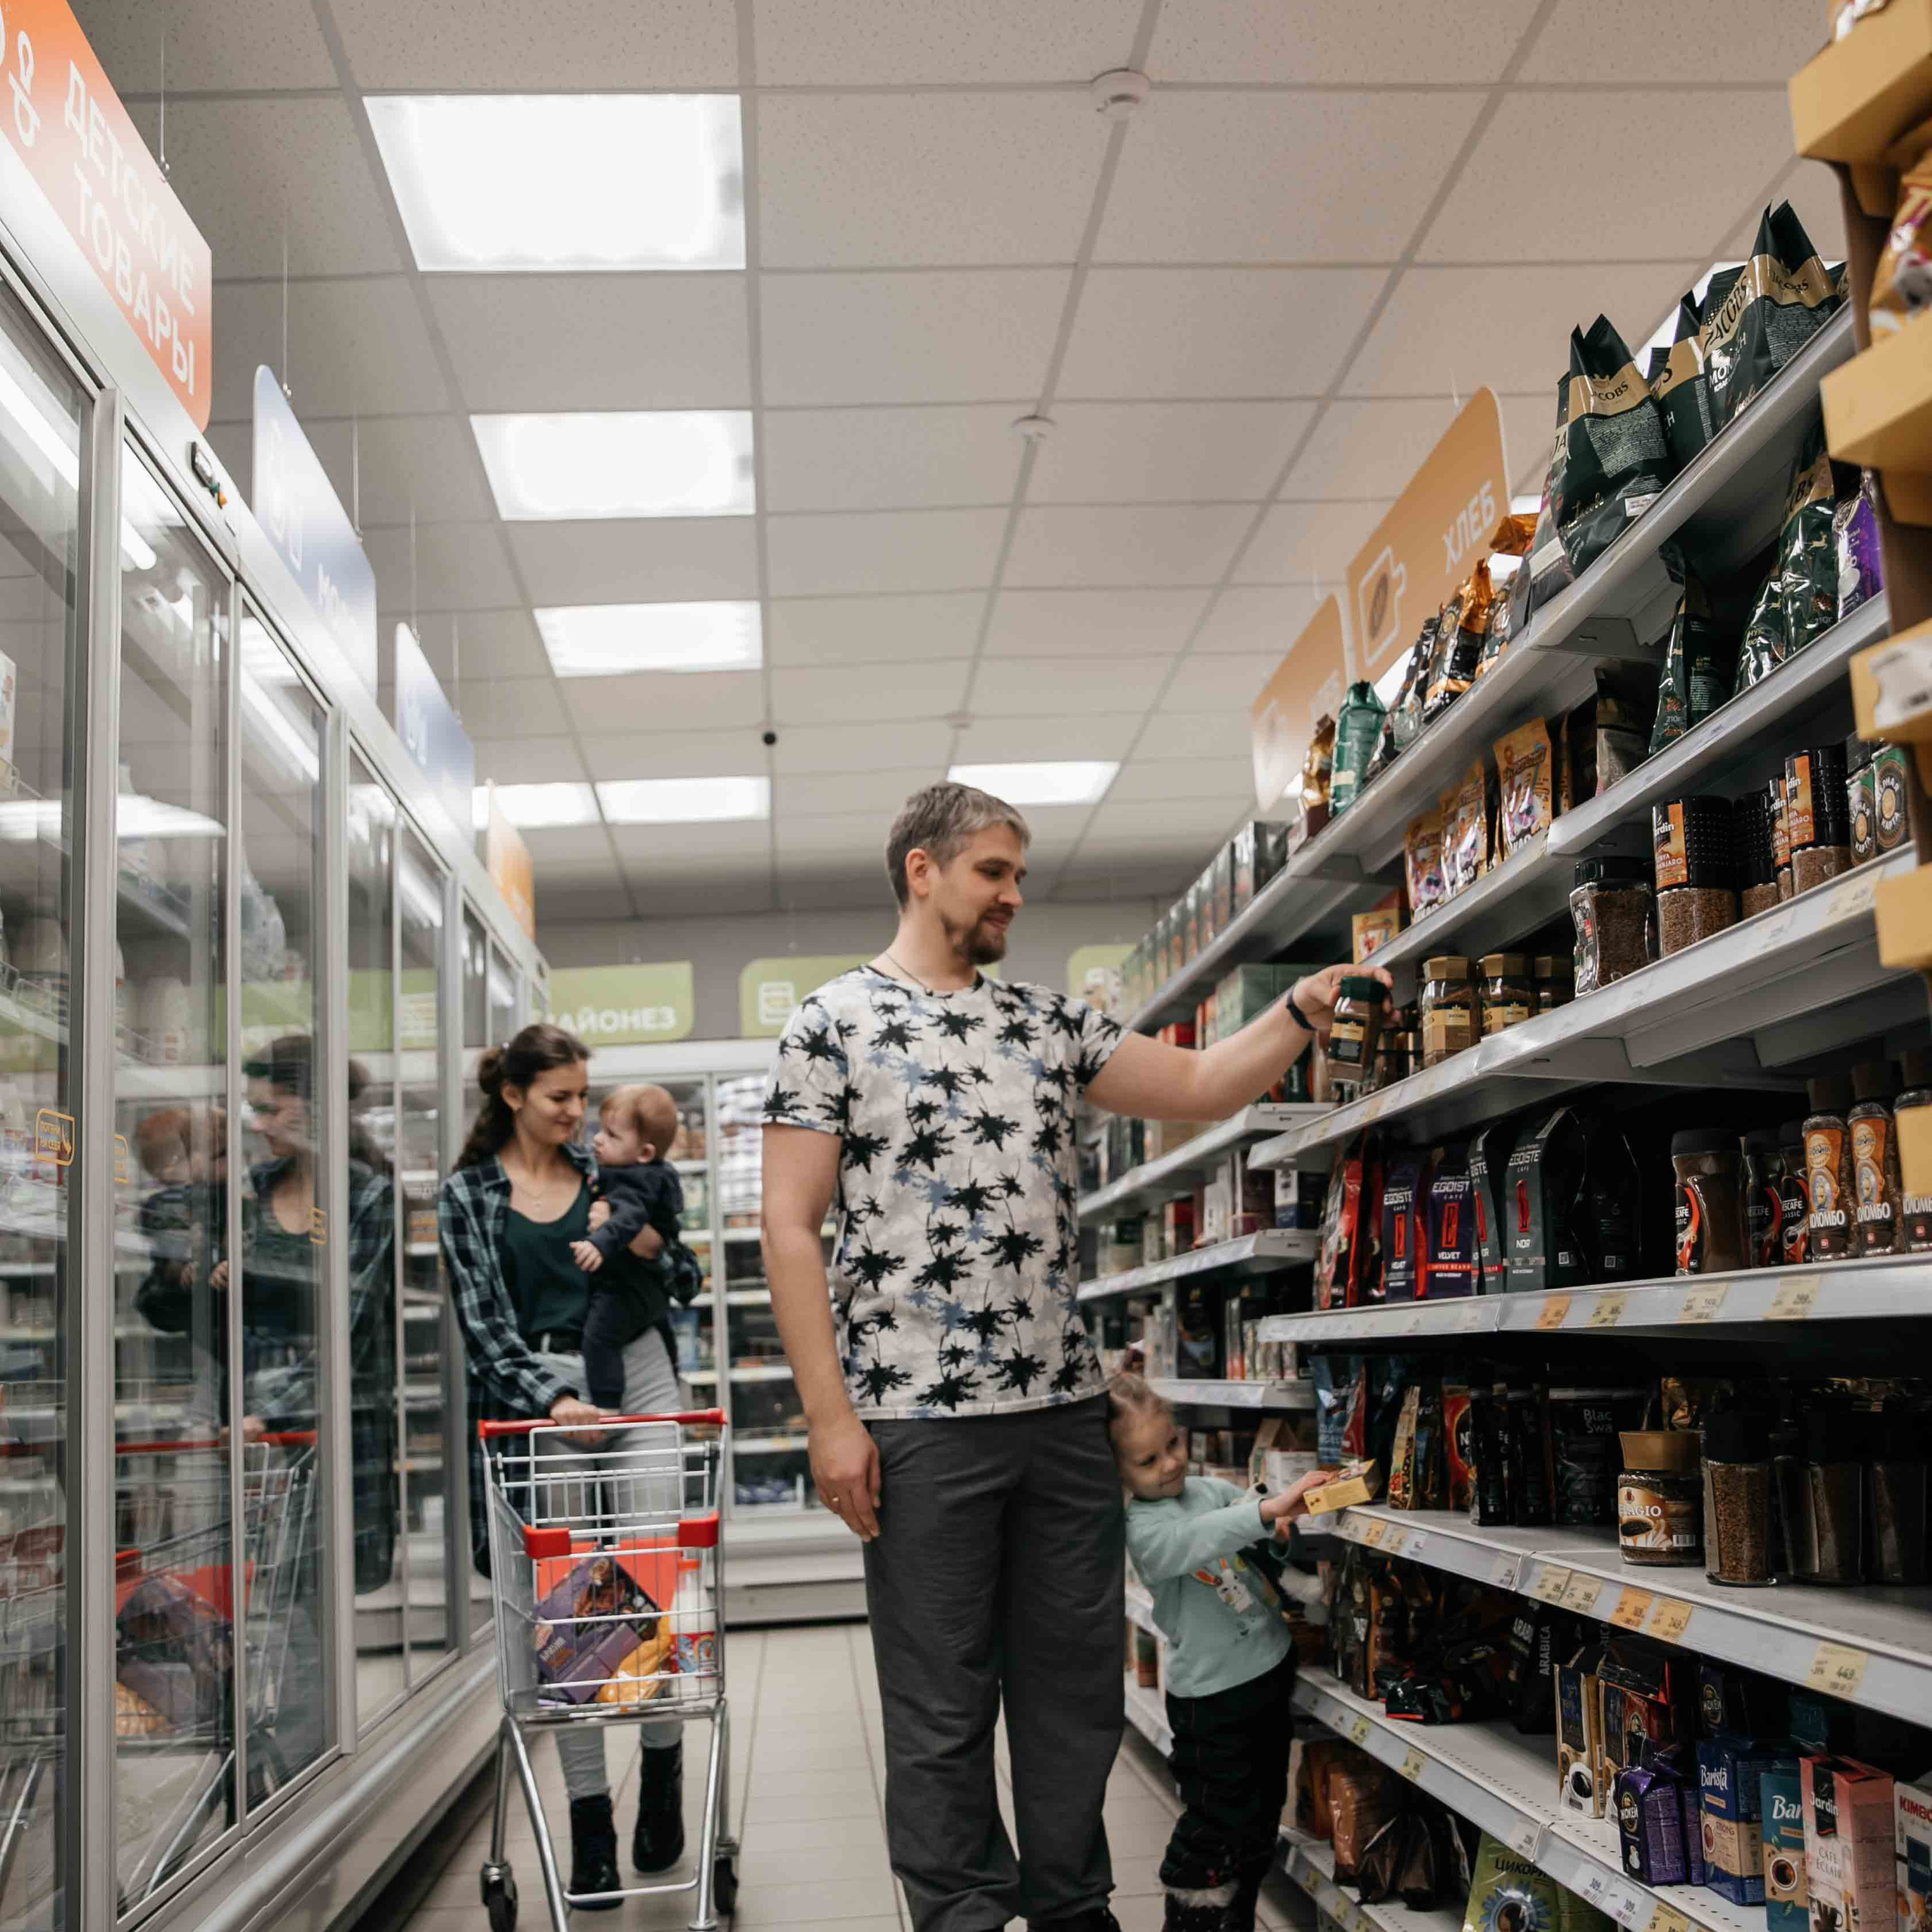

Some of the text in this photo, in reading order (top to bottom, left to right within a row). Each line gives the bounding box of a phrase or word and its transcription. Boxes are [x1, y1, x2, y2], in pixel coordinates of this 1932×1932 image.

[65, 59, 195, 316] ДЕТСКИЕ
[74, 160, 194, 395] ТОВАРЫ
[1703, 275, 1748, 352] JACOBS
[1443, 479, 1495, 575] ХЛЕБ
[545, 1006, 677, 1035] АЙОНЕЗ
[1811, 1792, 1839, 1817] Jardin
